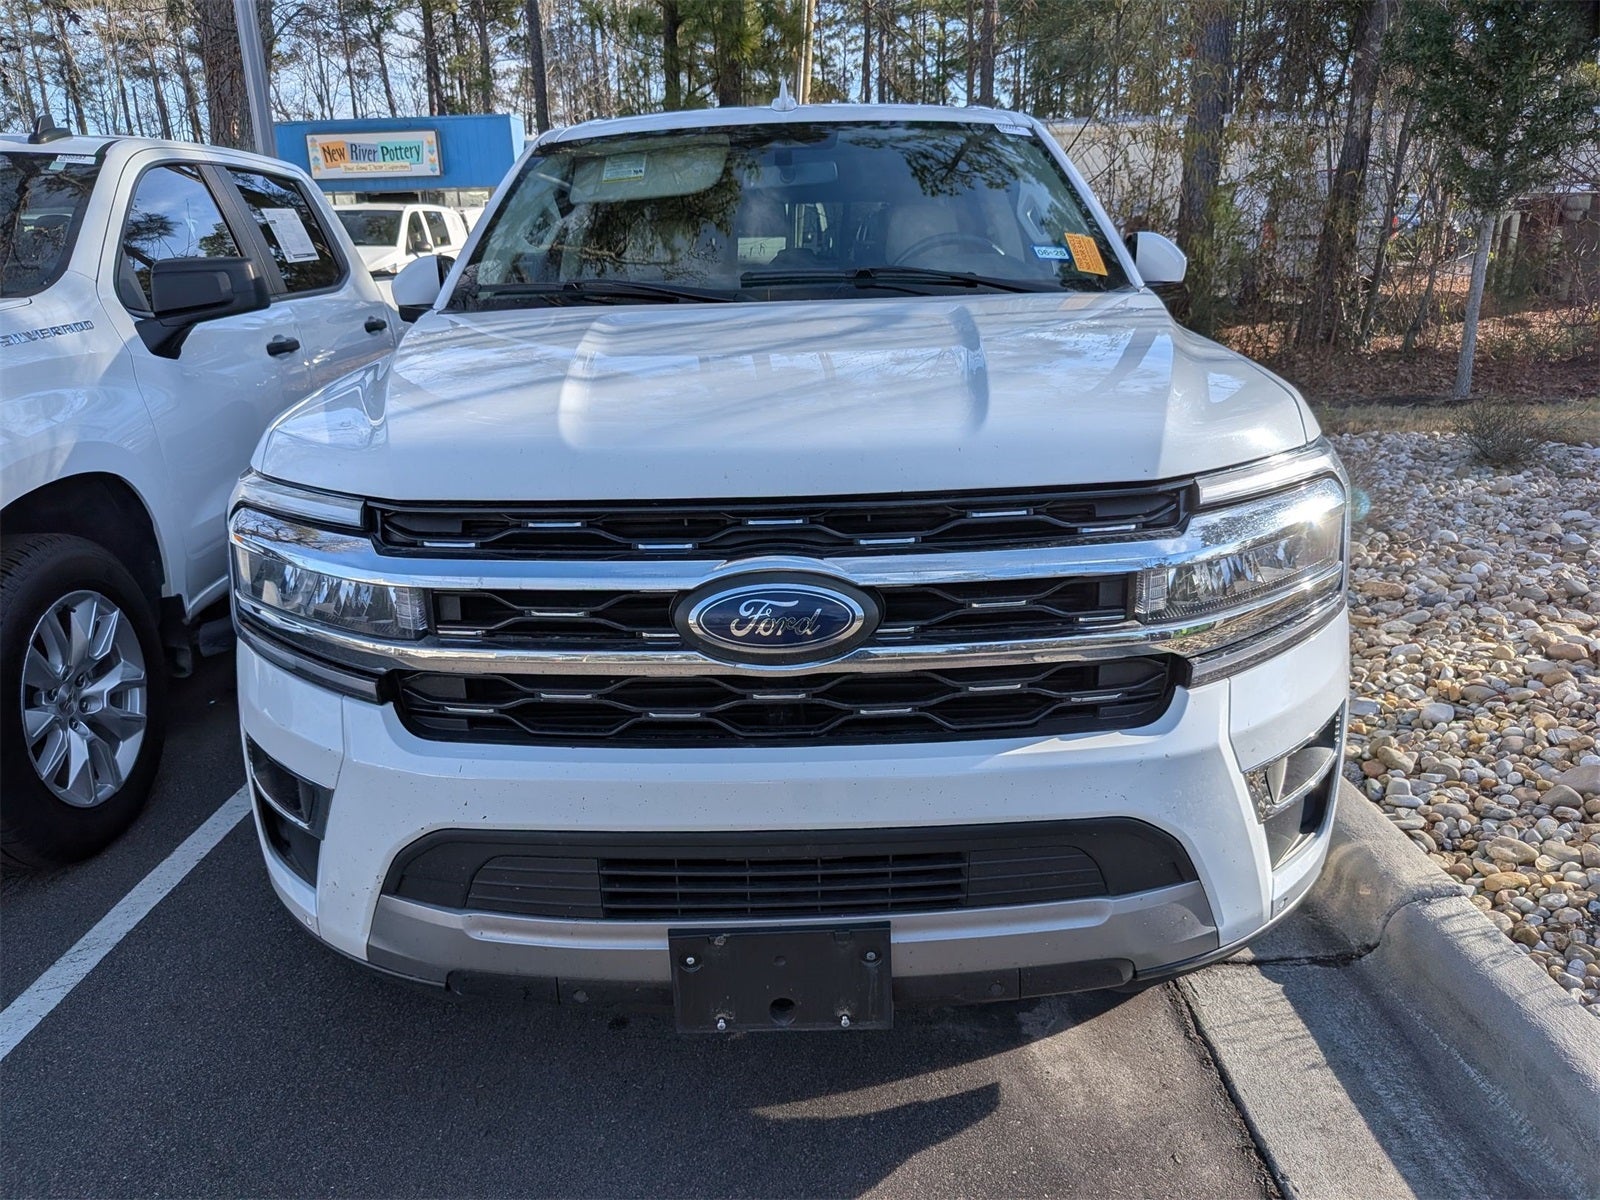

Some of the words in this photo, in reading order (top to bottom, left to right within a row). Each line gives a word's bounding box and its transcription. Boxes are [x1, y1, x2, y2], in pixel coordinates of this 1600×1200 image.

[322, 145, 345, 163] New
[350, 144, 377, 161] River
[381, 145, 420, 161] Pottery
[0, 320, 94, 347] SILVERADO
[729, 598, 822, 637] Ford
